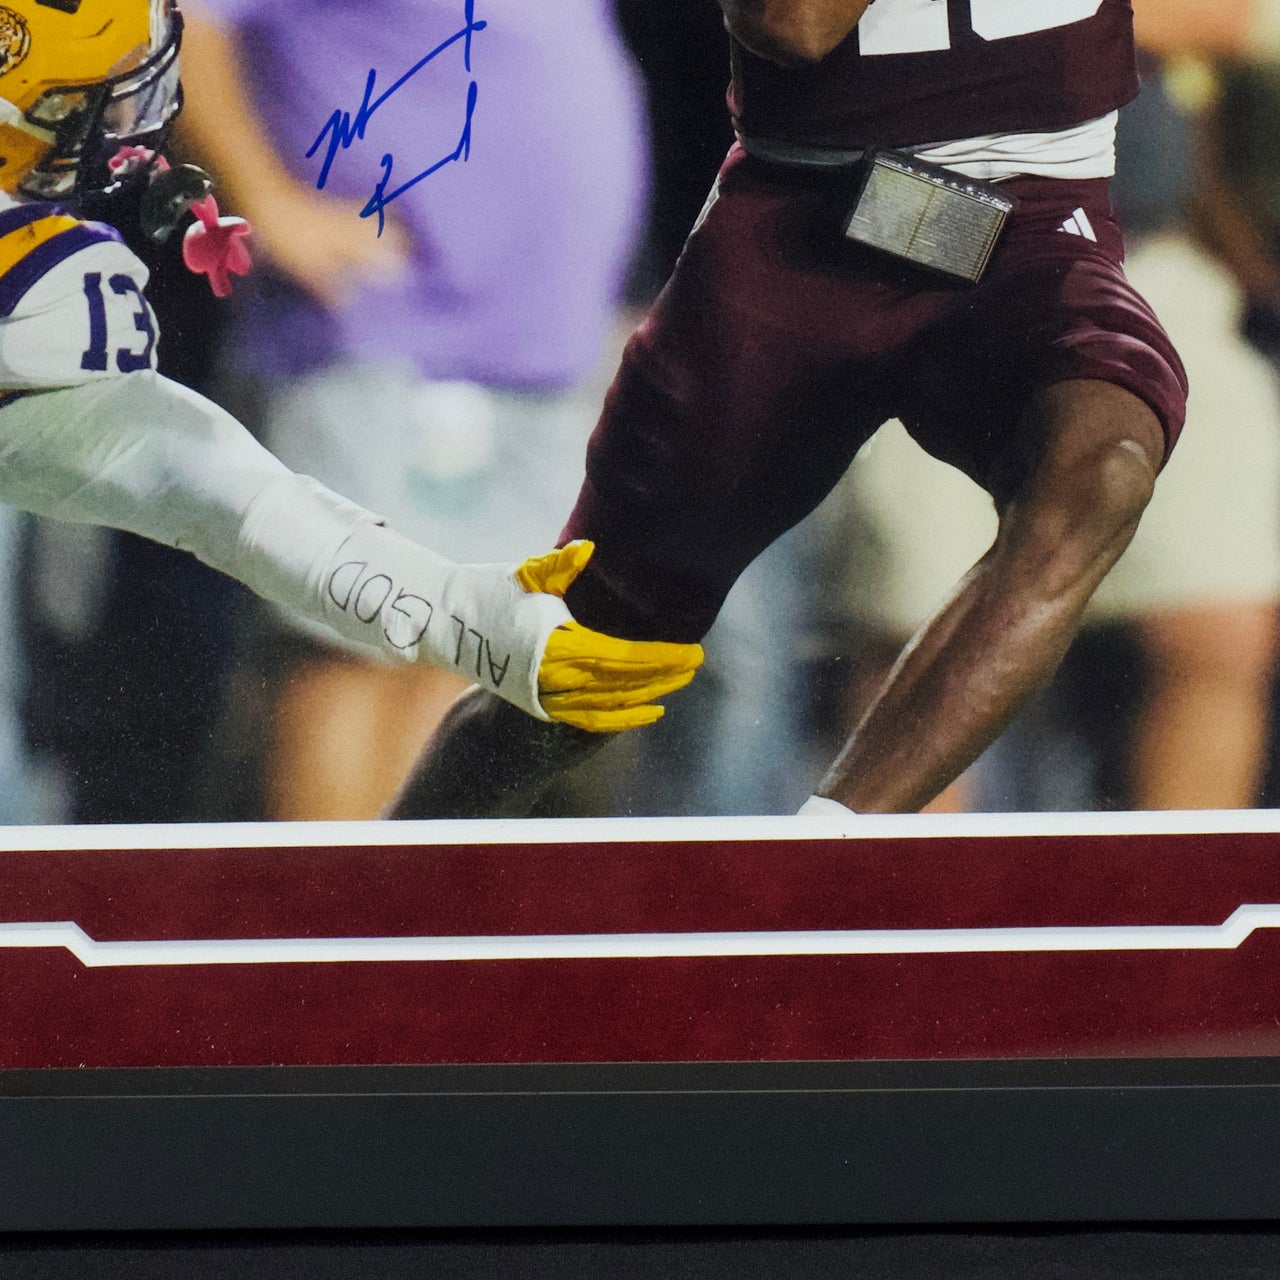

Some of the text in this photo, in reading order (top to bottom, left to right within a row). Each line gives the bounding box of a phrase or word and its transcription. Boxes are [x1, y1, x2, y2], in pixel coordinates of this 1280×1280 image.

[80, 271, 156, 374] 13
[327, 561, 511, 688] ALL GOD
